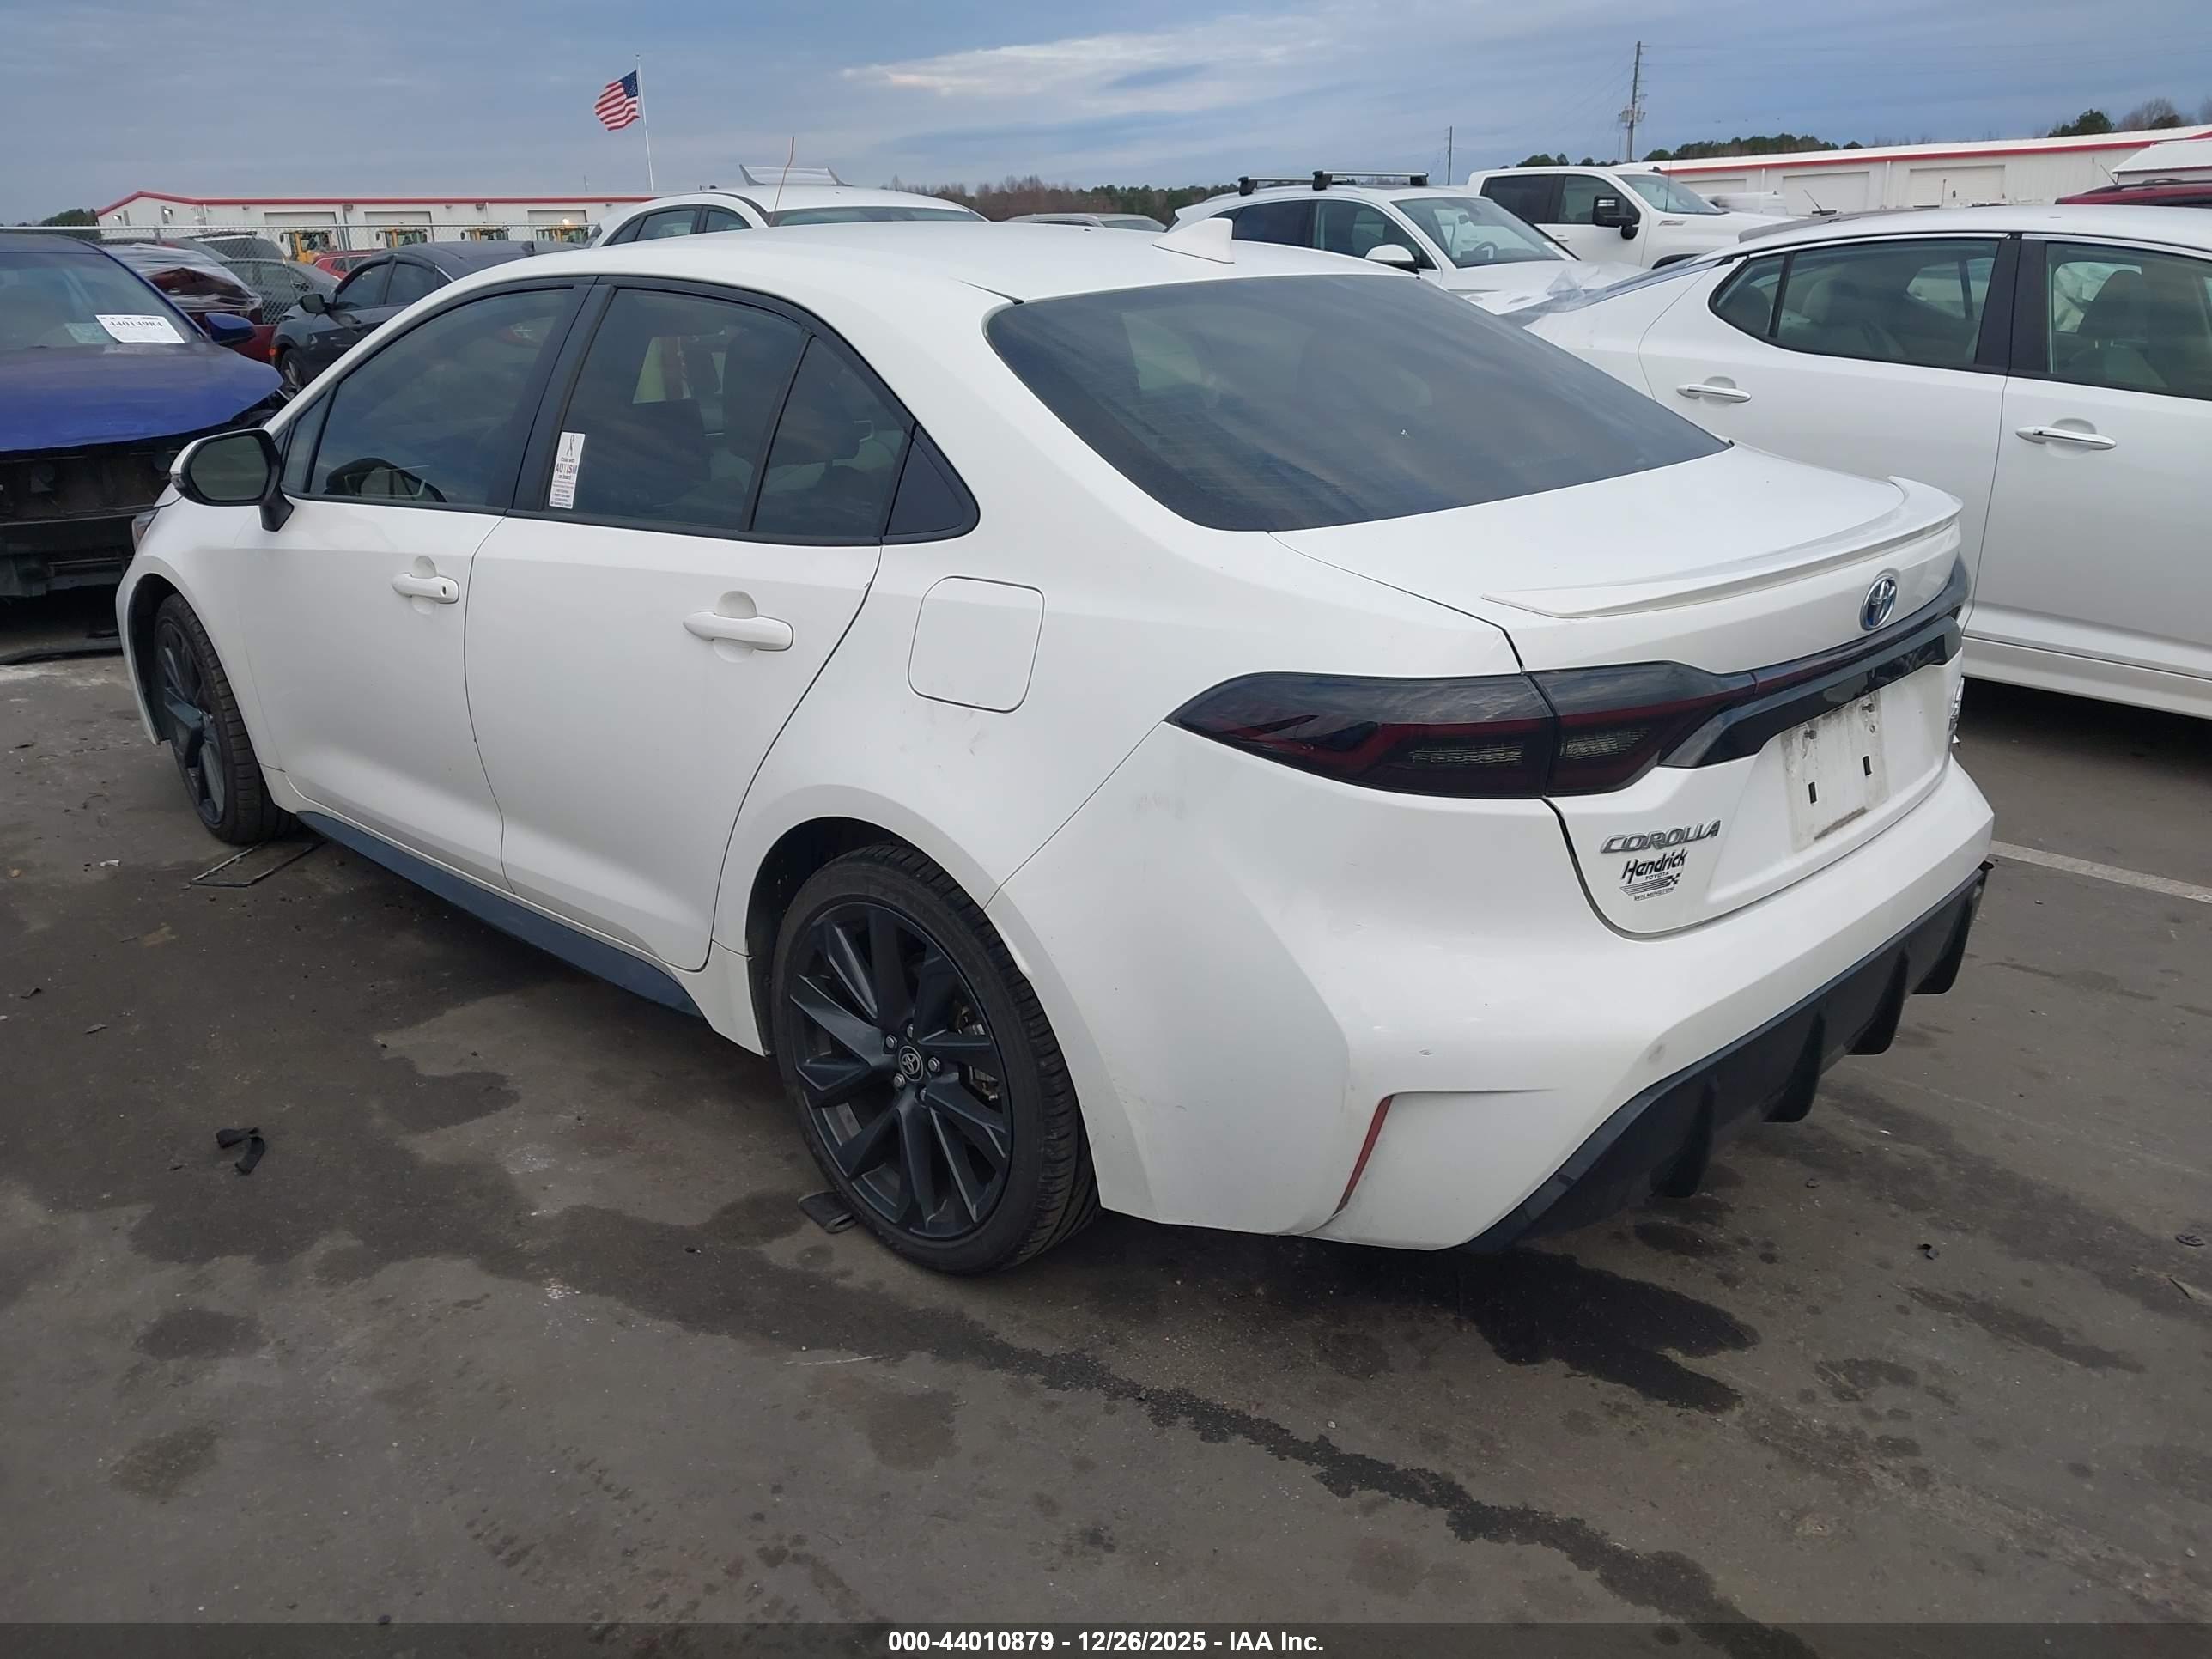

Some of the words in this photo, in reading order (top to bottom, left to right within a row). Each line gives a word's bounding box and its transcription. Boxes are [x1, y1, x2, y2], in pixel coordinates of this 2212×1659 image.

[555, 463, 577, 474] AUTISM
[1600, 818, 1721, 854] COROLLA
[1620, 848, 1688, 884] Hendrick
[1645, 871, 1670, 881] TOYOTA
[1634, 886, 1674, 901] WILMINGTON
